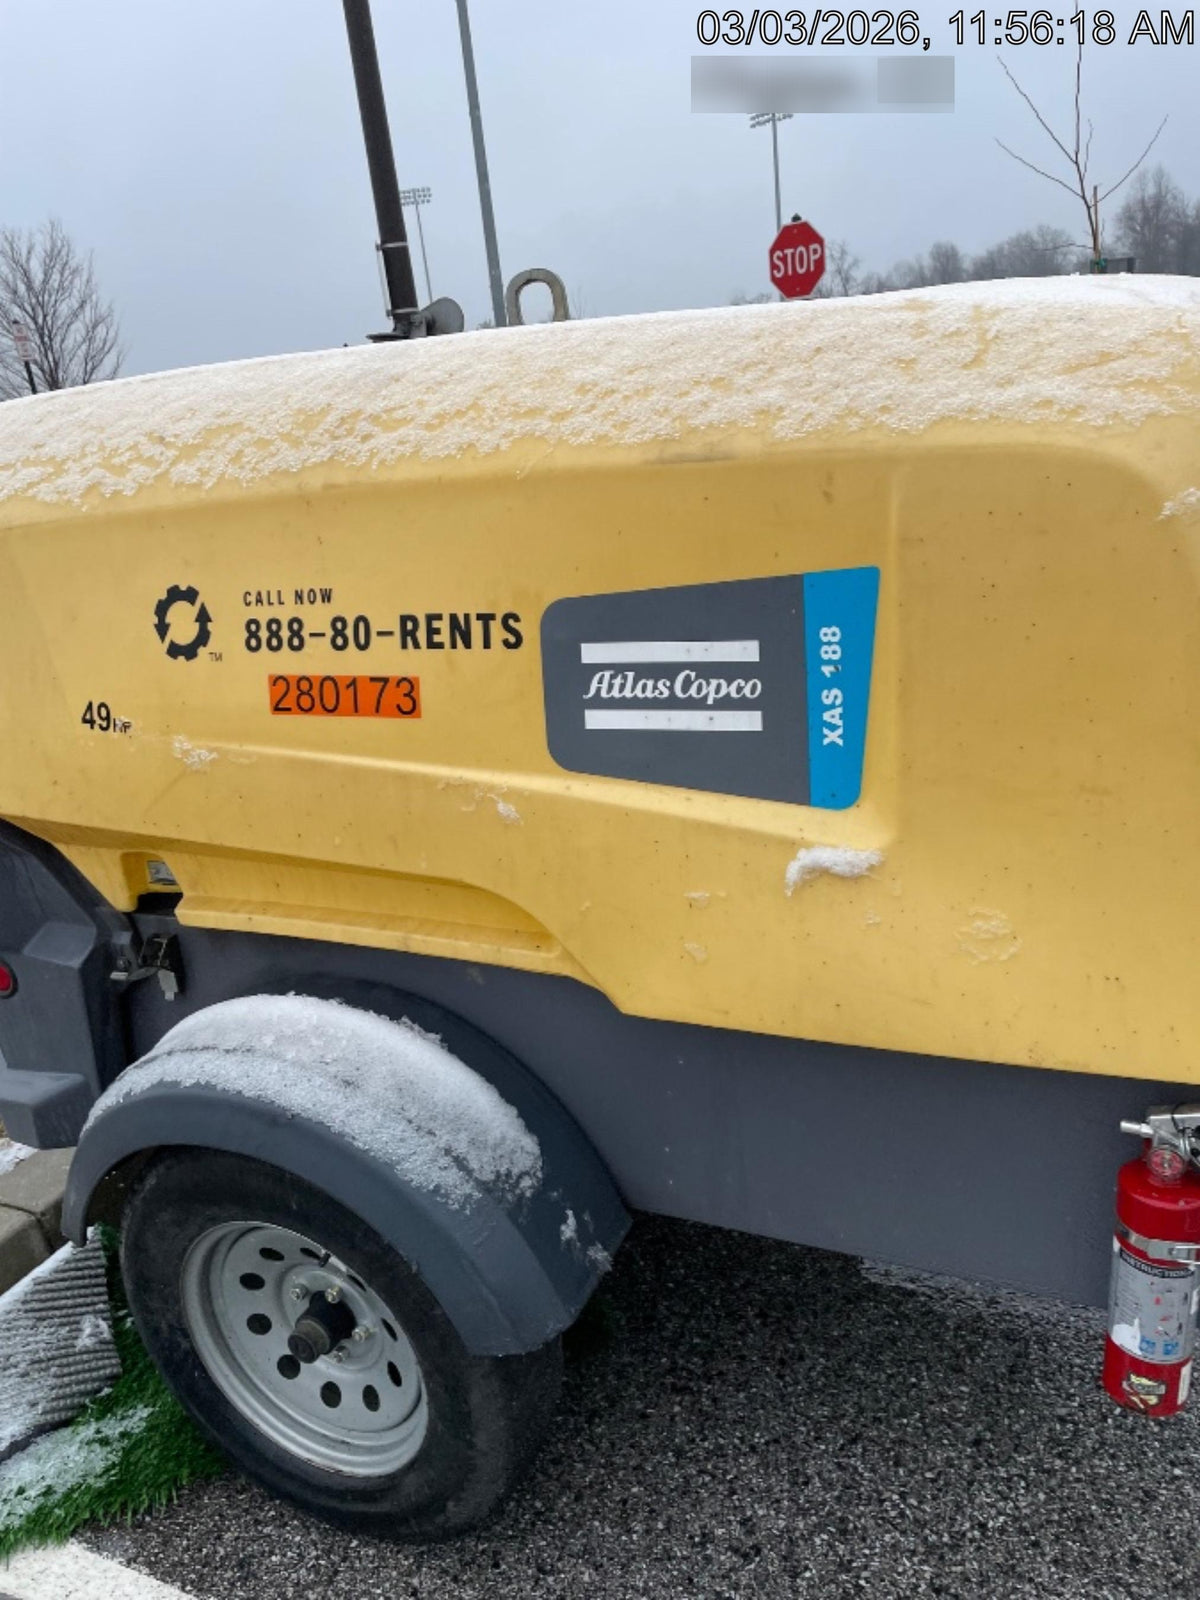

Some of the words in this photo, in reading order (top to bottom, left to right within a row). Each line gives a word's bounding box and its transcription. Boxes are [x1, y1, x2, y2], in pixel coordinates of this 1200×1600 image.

[772, 243, 823, 279] STOP
[243, 591, 285, 607] CALL
[294, 588, 333, 604] NOW
[244, 612, 524, 653] 888-80-RENTS
[208, 652, 223, 662] TM
[819, 625, 843, 678] 188
[271, 676, 418, 716] 280173
[583, 670, 671, 700] Atlas
[673, 670, 762, 704] Copco
[81, 701, 111, 731] 49
[822, 688, 844, 747] XAS
